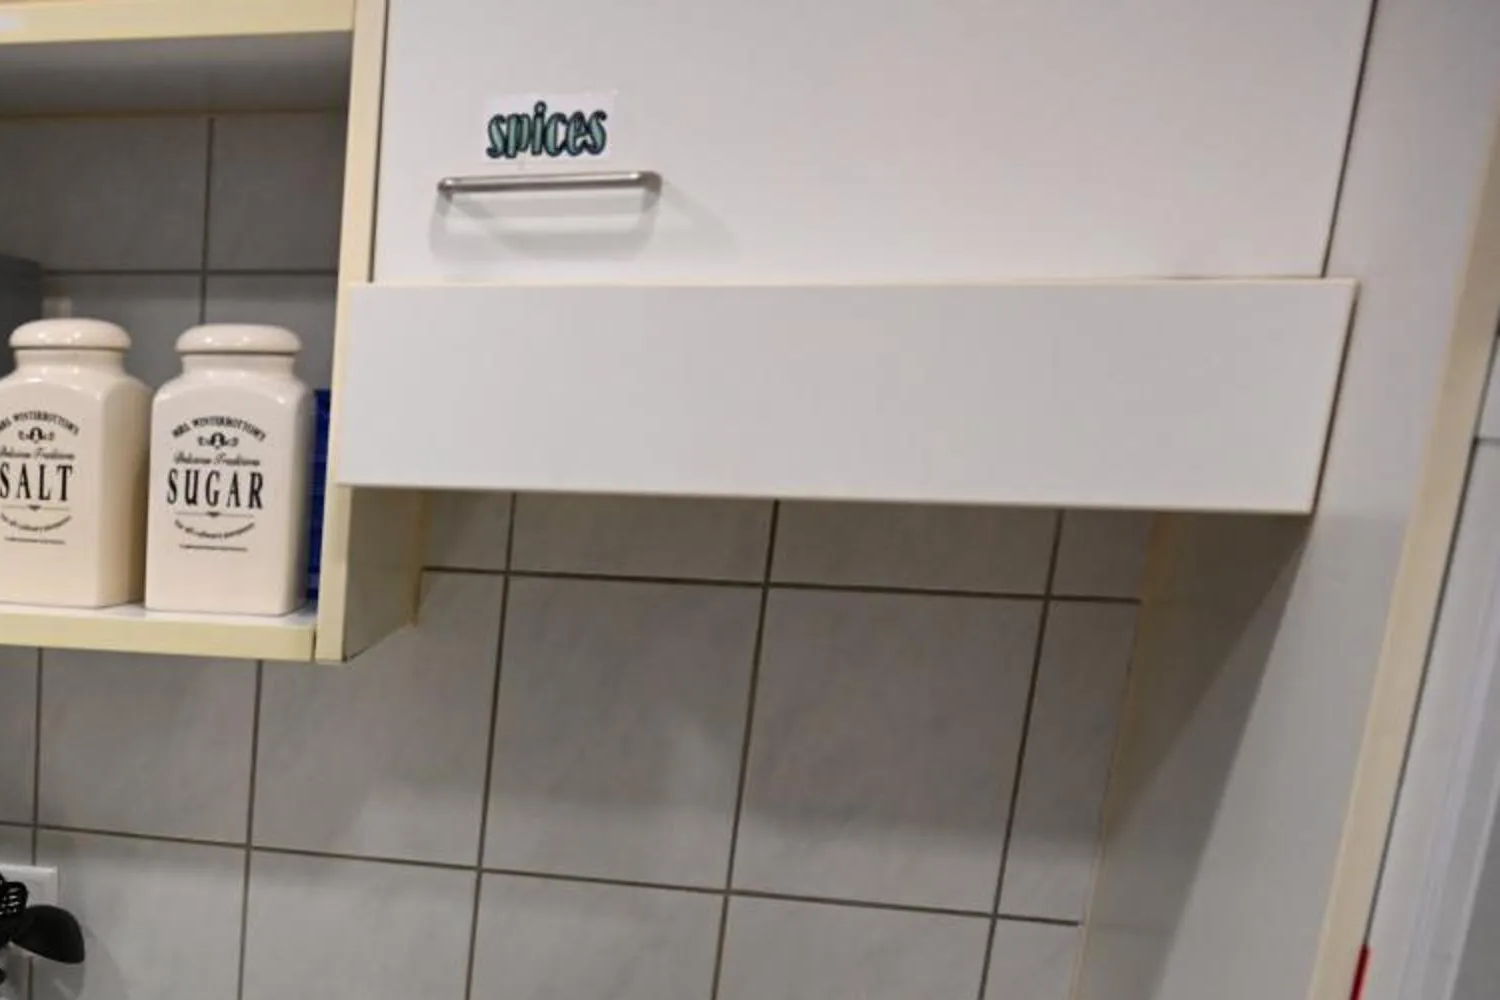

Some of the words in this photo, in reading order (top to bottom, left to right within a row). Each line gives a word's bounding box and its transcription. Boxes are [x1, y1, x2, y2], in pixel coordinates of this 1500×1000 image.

[486, 100, 607, 158] spices
[0, 462, 73, 501] SALT
[167, 468, 263, 509] SUGAR
